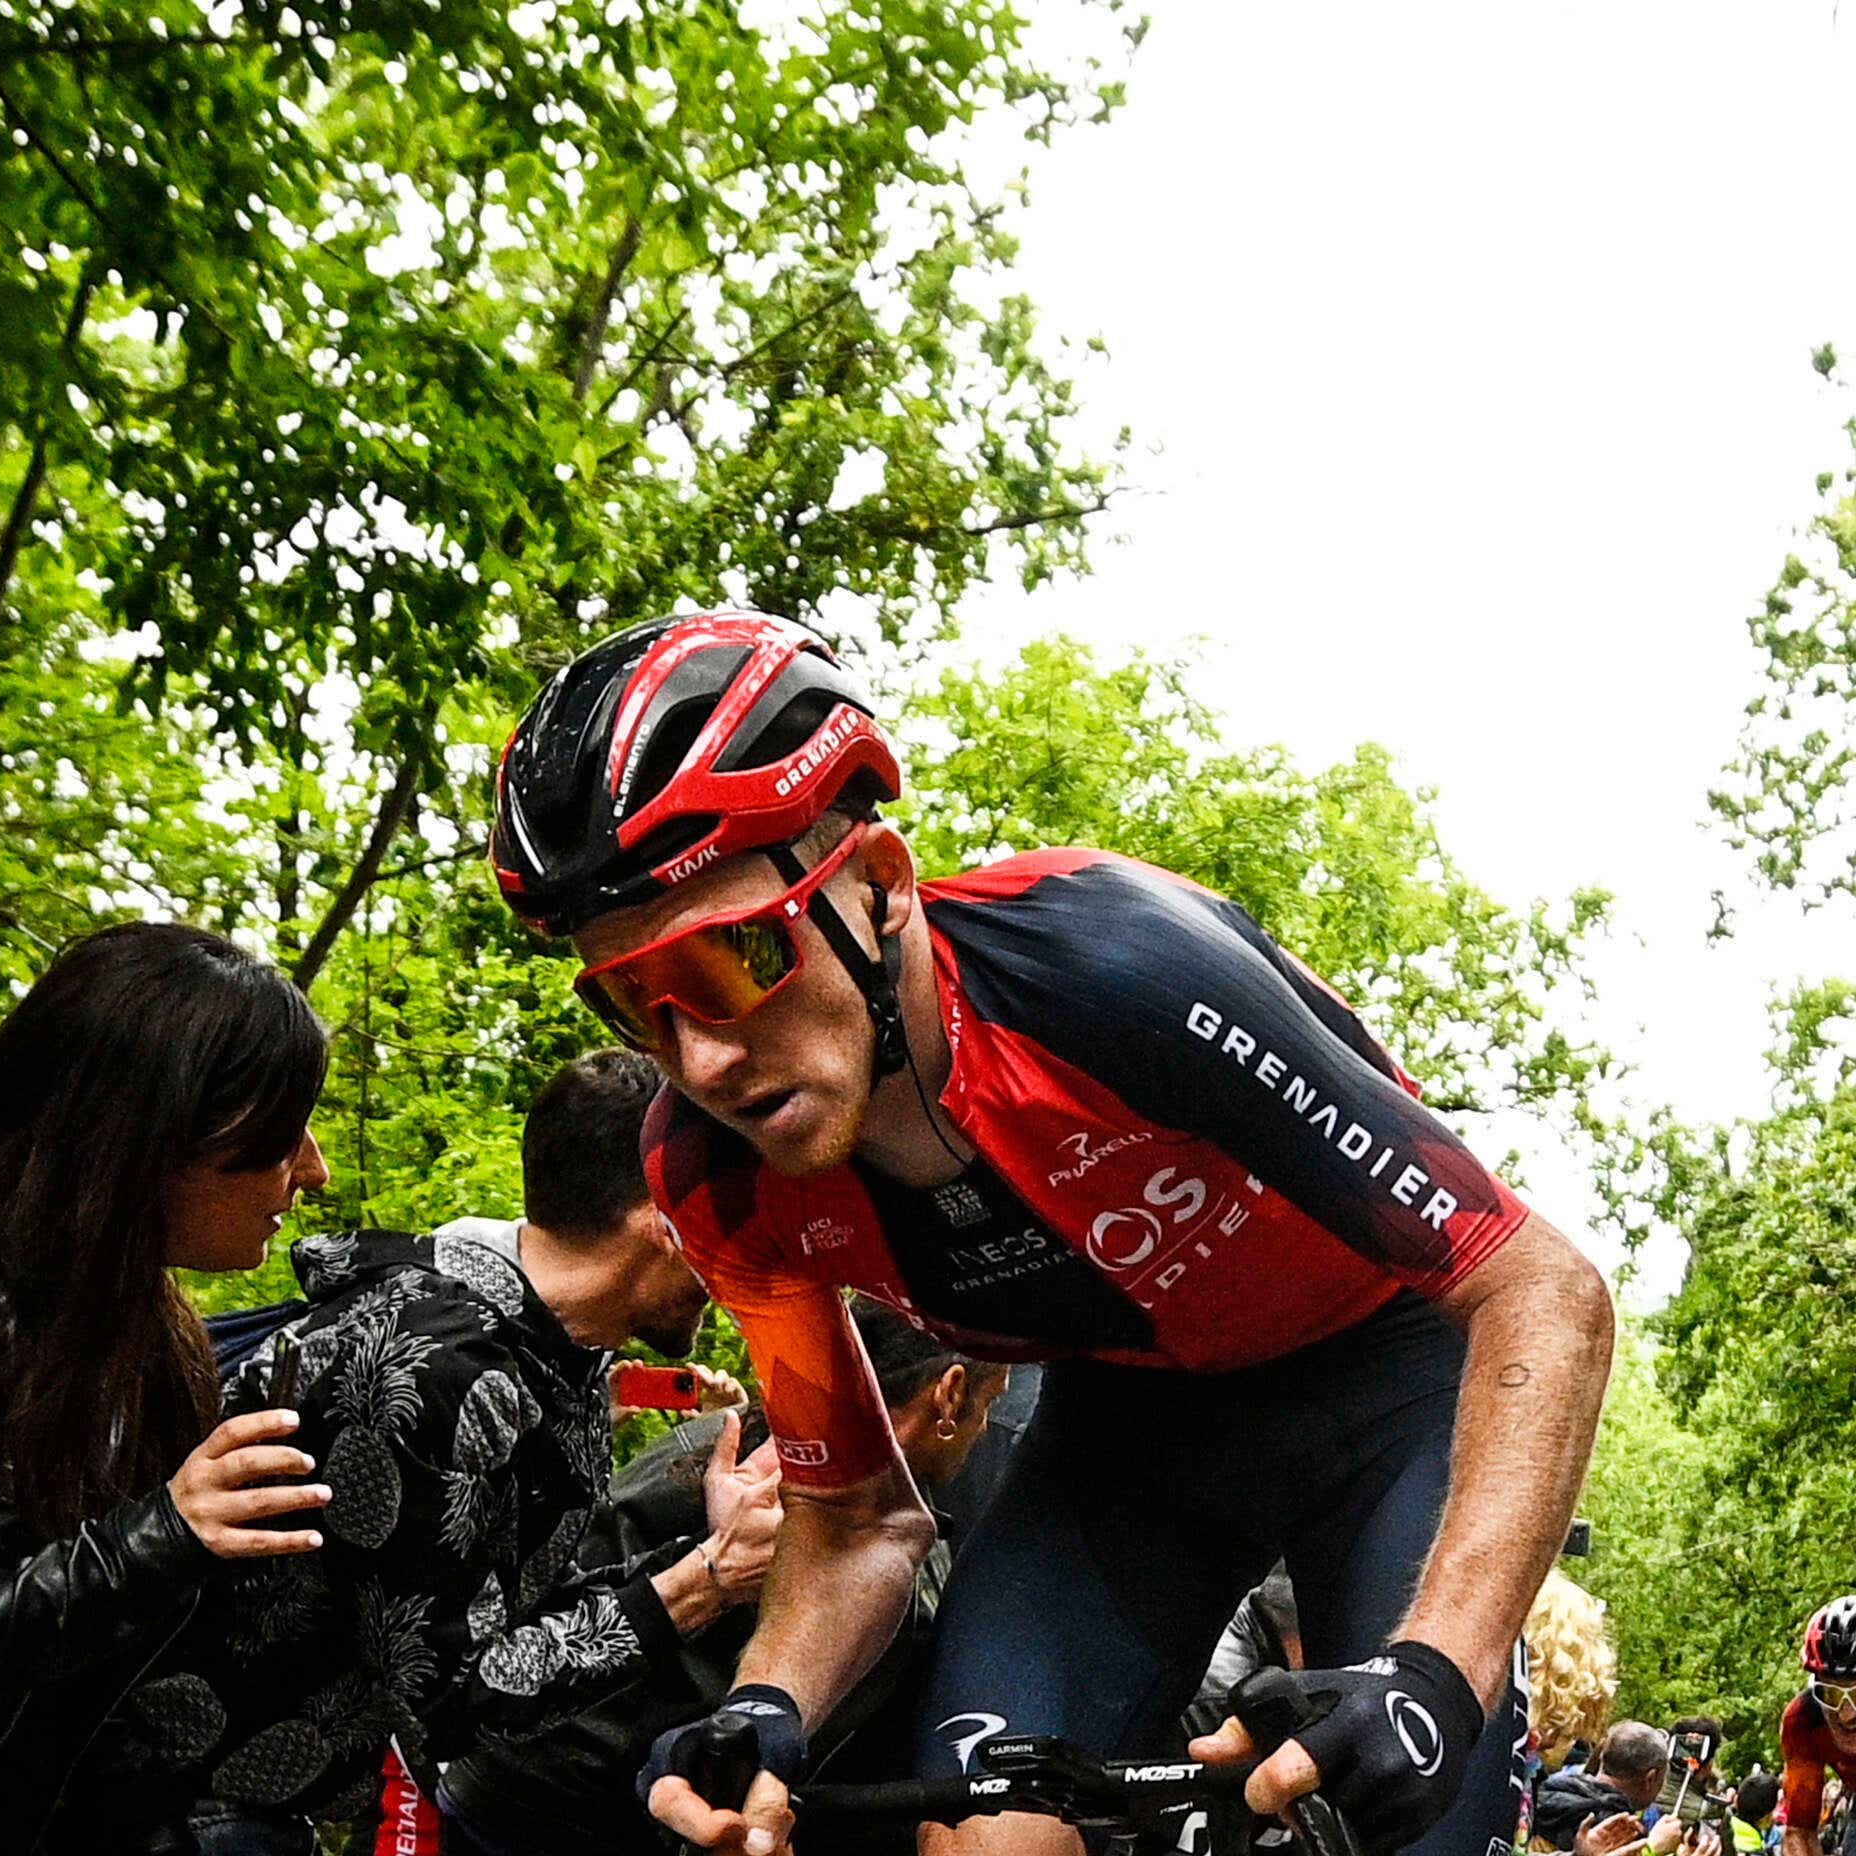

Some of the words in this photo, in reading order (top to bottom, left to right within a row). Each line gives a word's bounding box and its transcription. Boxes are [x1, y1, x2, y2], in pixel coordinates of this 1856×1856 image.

[774, 710, 860, 798] GRENADIER
[1186, 1000, 1460, 1232] GRENADIER
[988, 1743, 1034, 1756] GARMIN
